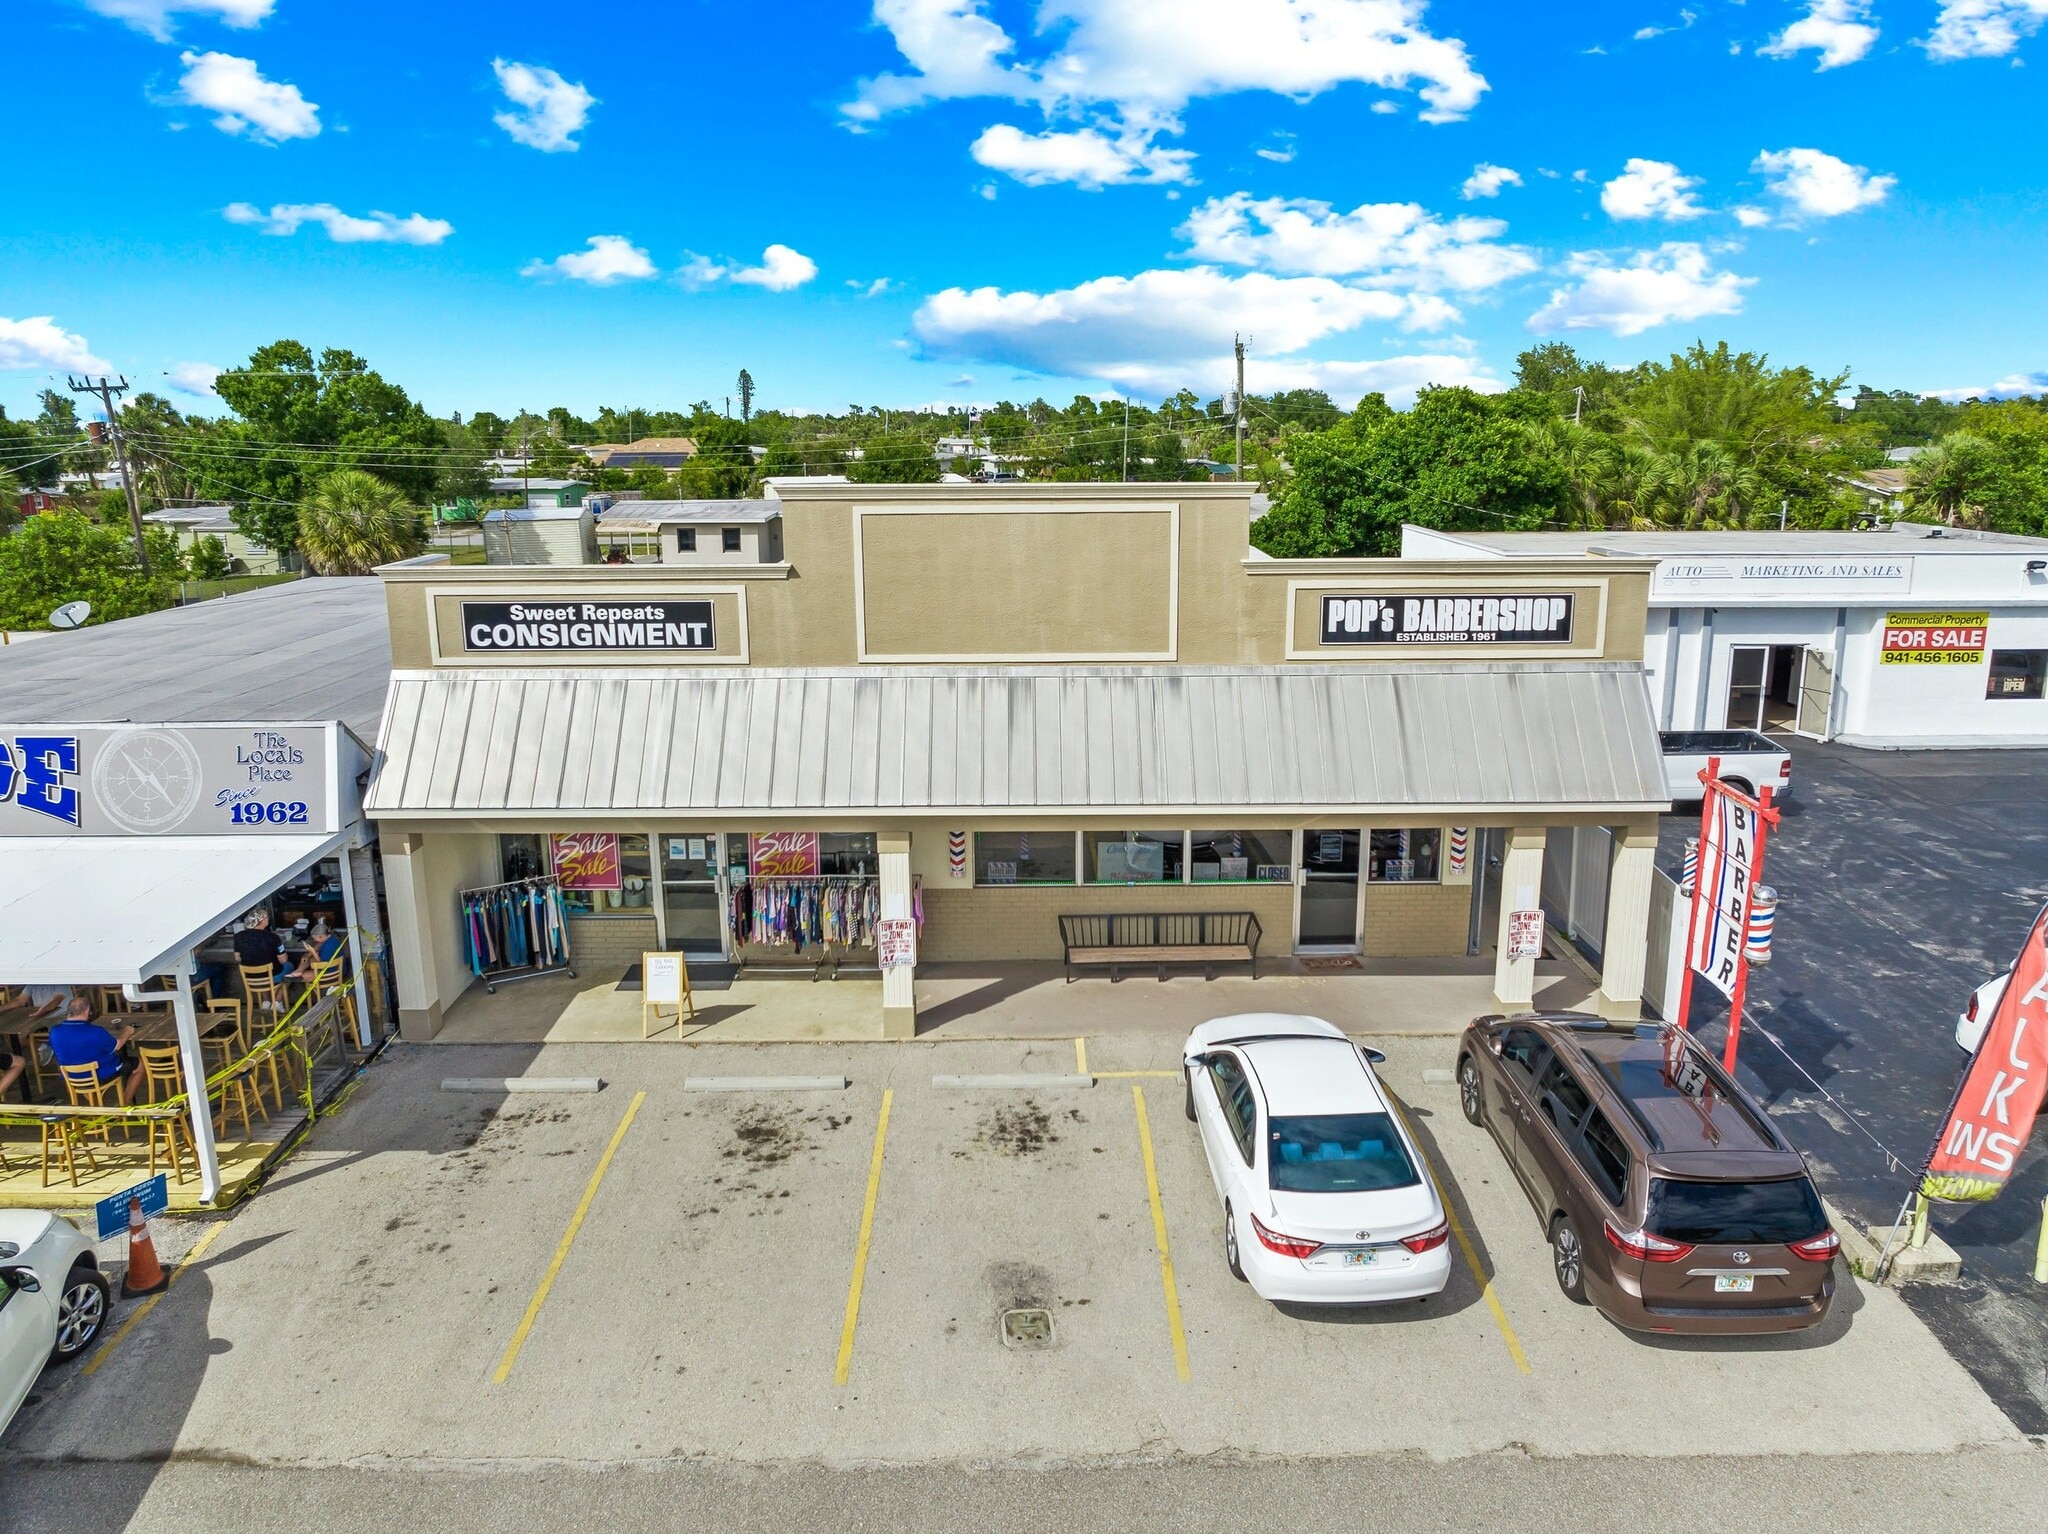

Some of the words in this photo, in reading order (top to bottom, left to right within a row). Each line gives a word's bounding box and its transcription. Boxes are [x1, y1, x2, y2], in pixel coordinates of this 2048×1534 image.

[1666, 566, 1703, 577] AUTO
[1741, 565, 1824, 577] MARKETING
[1827, 565, 1858, 576] AND
[1861, 565, 1903, 576] SALES
[509, 604, 577, 621] Sweet
[582, 604, 665, 624] Repeats
[1328, 600, 1395, 633] POP's
[1403, 598, 1566, 632] BARBERSHOP
[1889, 615, 1943, 625] Commercial
[1945, 615, 1985, 627] Property
[470, 622, 708, 647] CONSIGNMENT
[1396, 633, 1469, 642] ESTABLISHED
[1471, 633, 1497, 642] 1961
[1886, 630, 1926, 648] FOR
[1931, 630, 1983, 648] SALE
[253, 732, 288, 749] The
[236, 745, 305, 766] Locals
[247, 765, 293, 783] Place
[214, 786, 262, 809] Since
[230, 801, 309, 826] 1962
[554, 832, 616, 864] Sale
[753, 832, 815, 861] Sale
[560, 852, 617, 884] Sale
[1258, 866, 1289, 880] CLOSED
[1717, 804, 1747, 985] BARBER
[881, 922, 893, 932] TOW
[895, 921, 912, 930] AWAY
[1517, 922, 1531, 930] ZONE
[1523, 913, 1540, 921] AWAY
[889, 931, 904, 939] ZONE
[1944, 1118, 2020, 1172] INS
